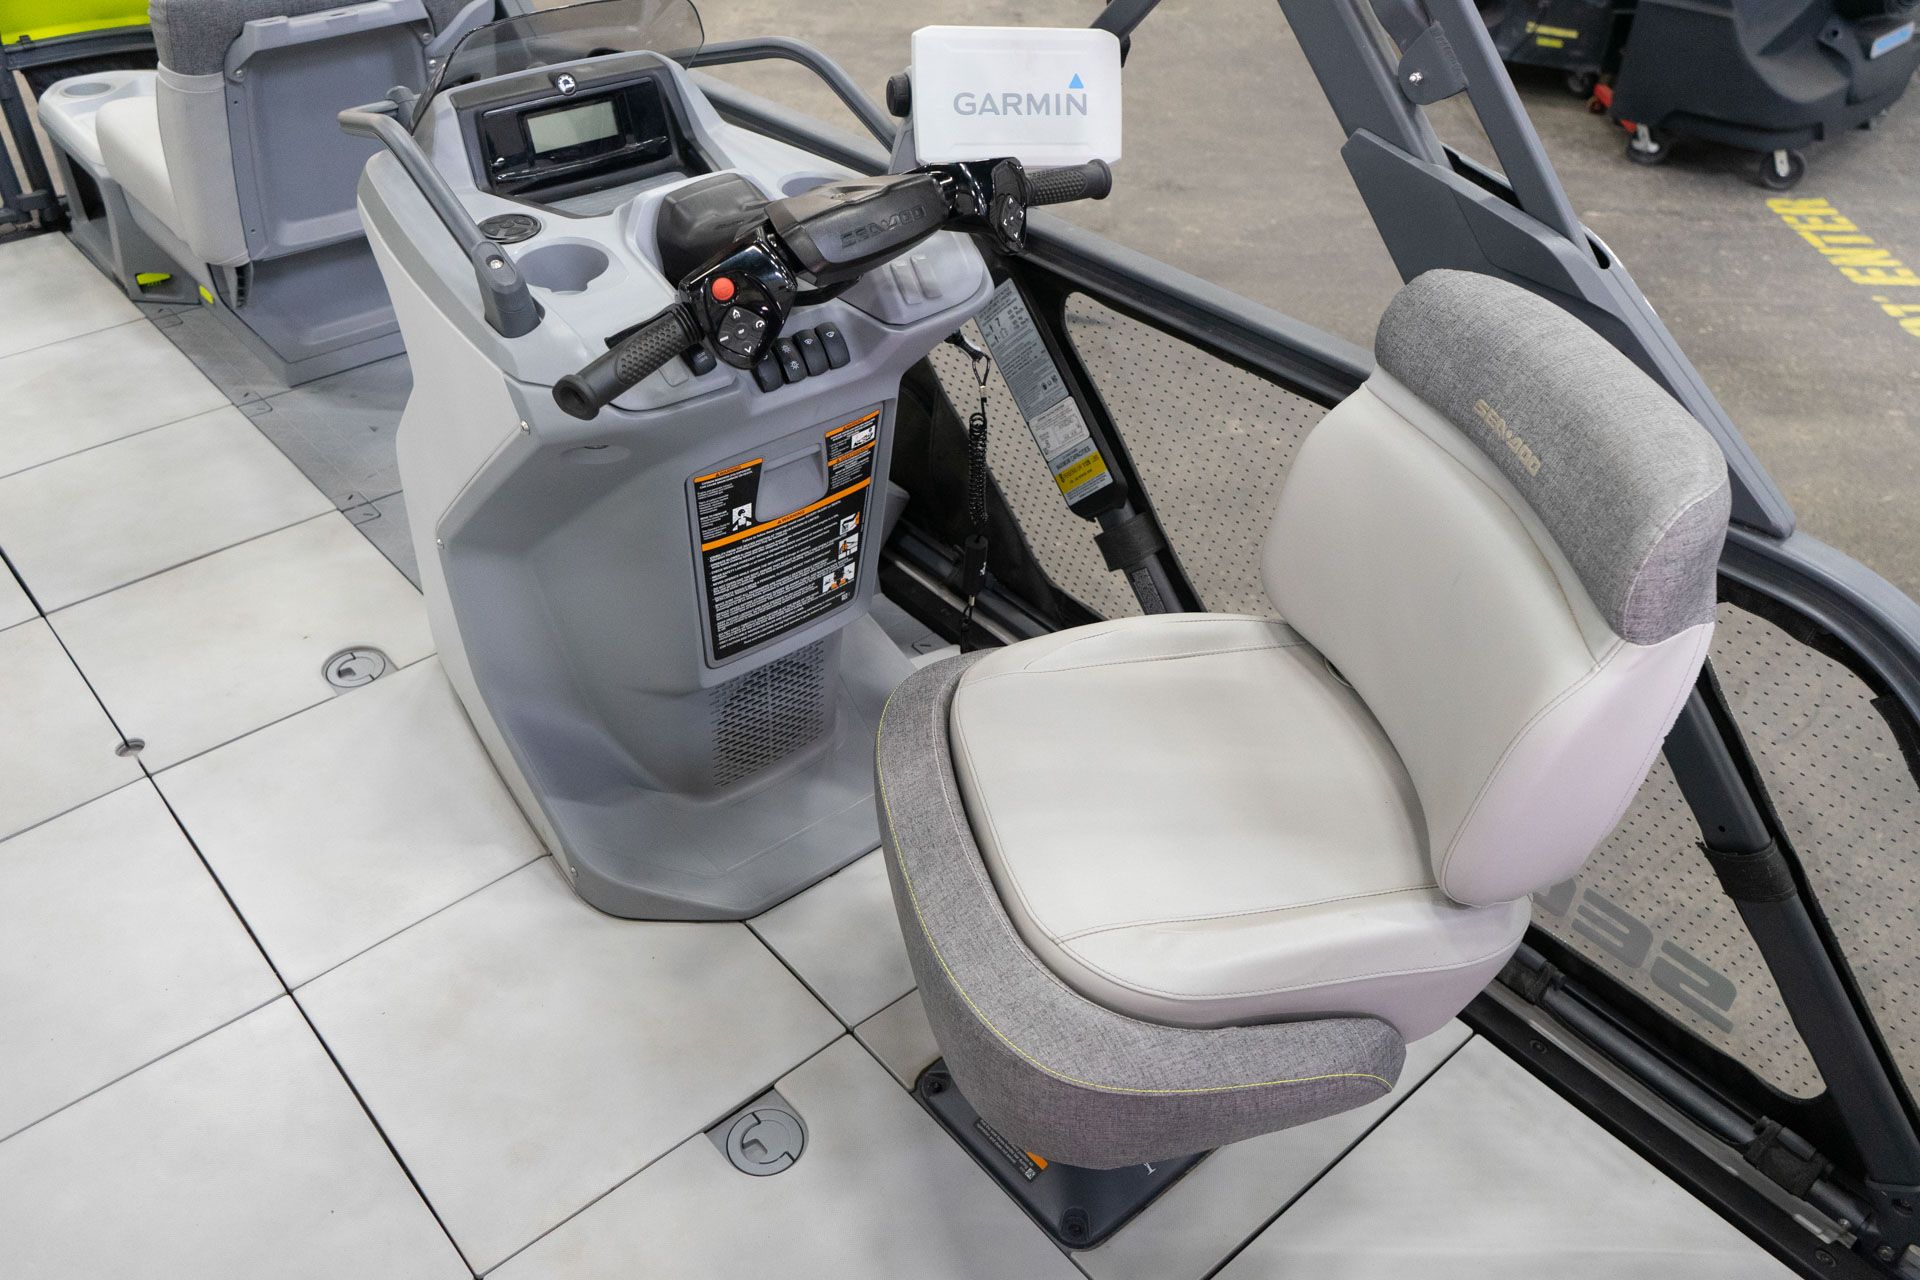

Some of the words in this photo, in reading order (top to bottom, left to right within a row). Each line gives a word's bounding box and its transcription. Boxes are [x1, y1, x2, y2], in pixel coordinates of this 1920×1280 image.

[953, 92, 1088, 116] GARMIN
[1766, 197, 1920, 286] ENTER
[781, 510, 805, 522] WARNING
